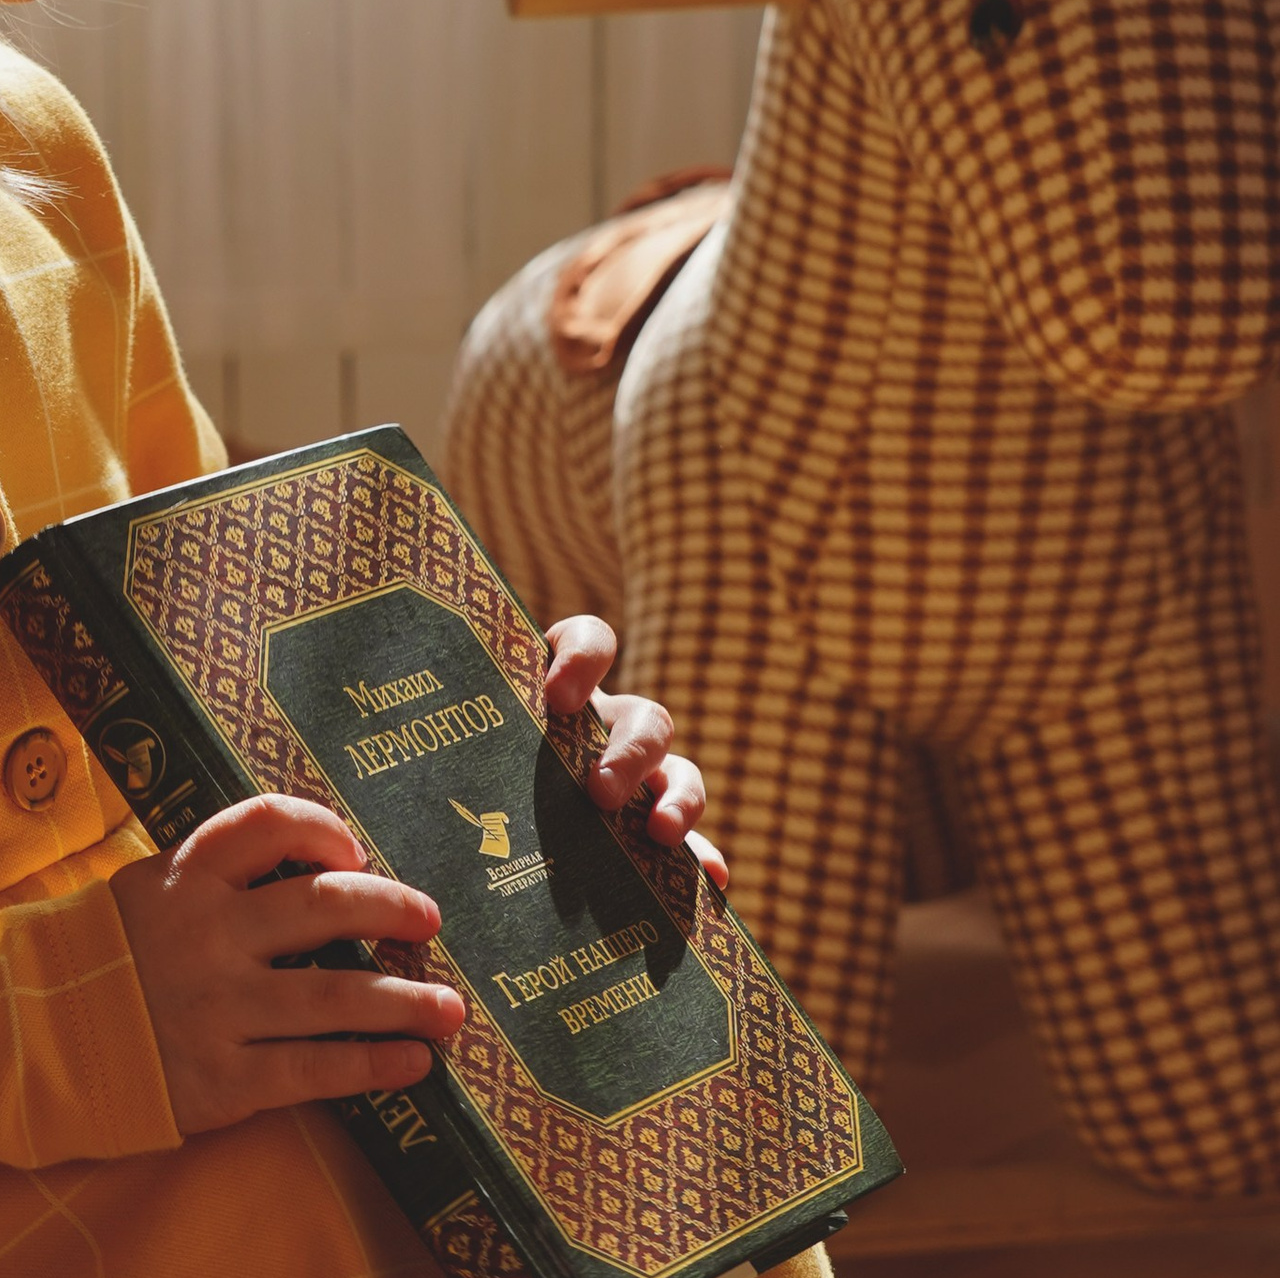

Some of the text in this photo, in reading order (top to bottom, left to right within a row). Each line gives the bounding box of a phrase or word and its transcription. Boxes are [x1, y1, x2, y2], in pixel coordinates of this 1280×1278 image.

[343, 669, 445, 718] Михаил
[343, 694, 505, 780] ЛЕРМОНТОВ
[499, 865, 555, 897] ЛИТЕРАТУРА
[570, 920, 659, 975] НАШЕГО
[557, 972, 660, 1035] ВРЕМЕНИ
